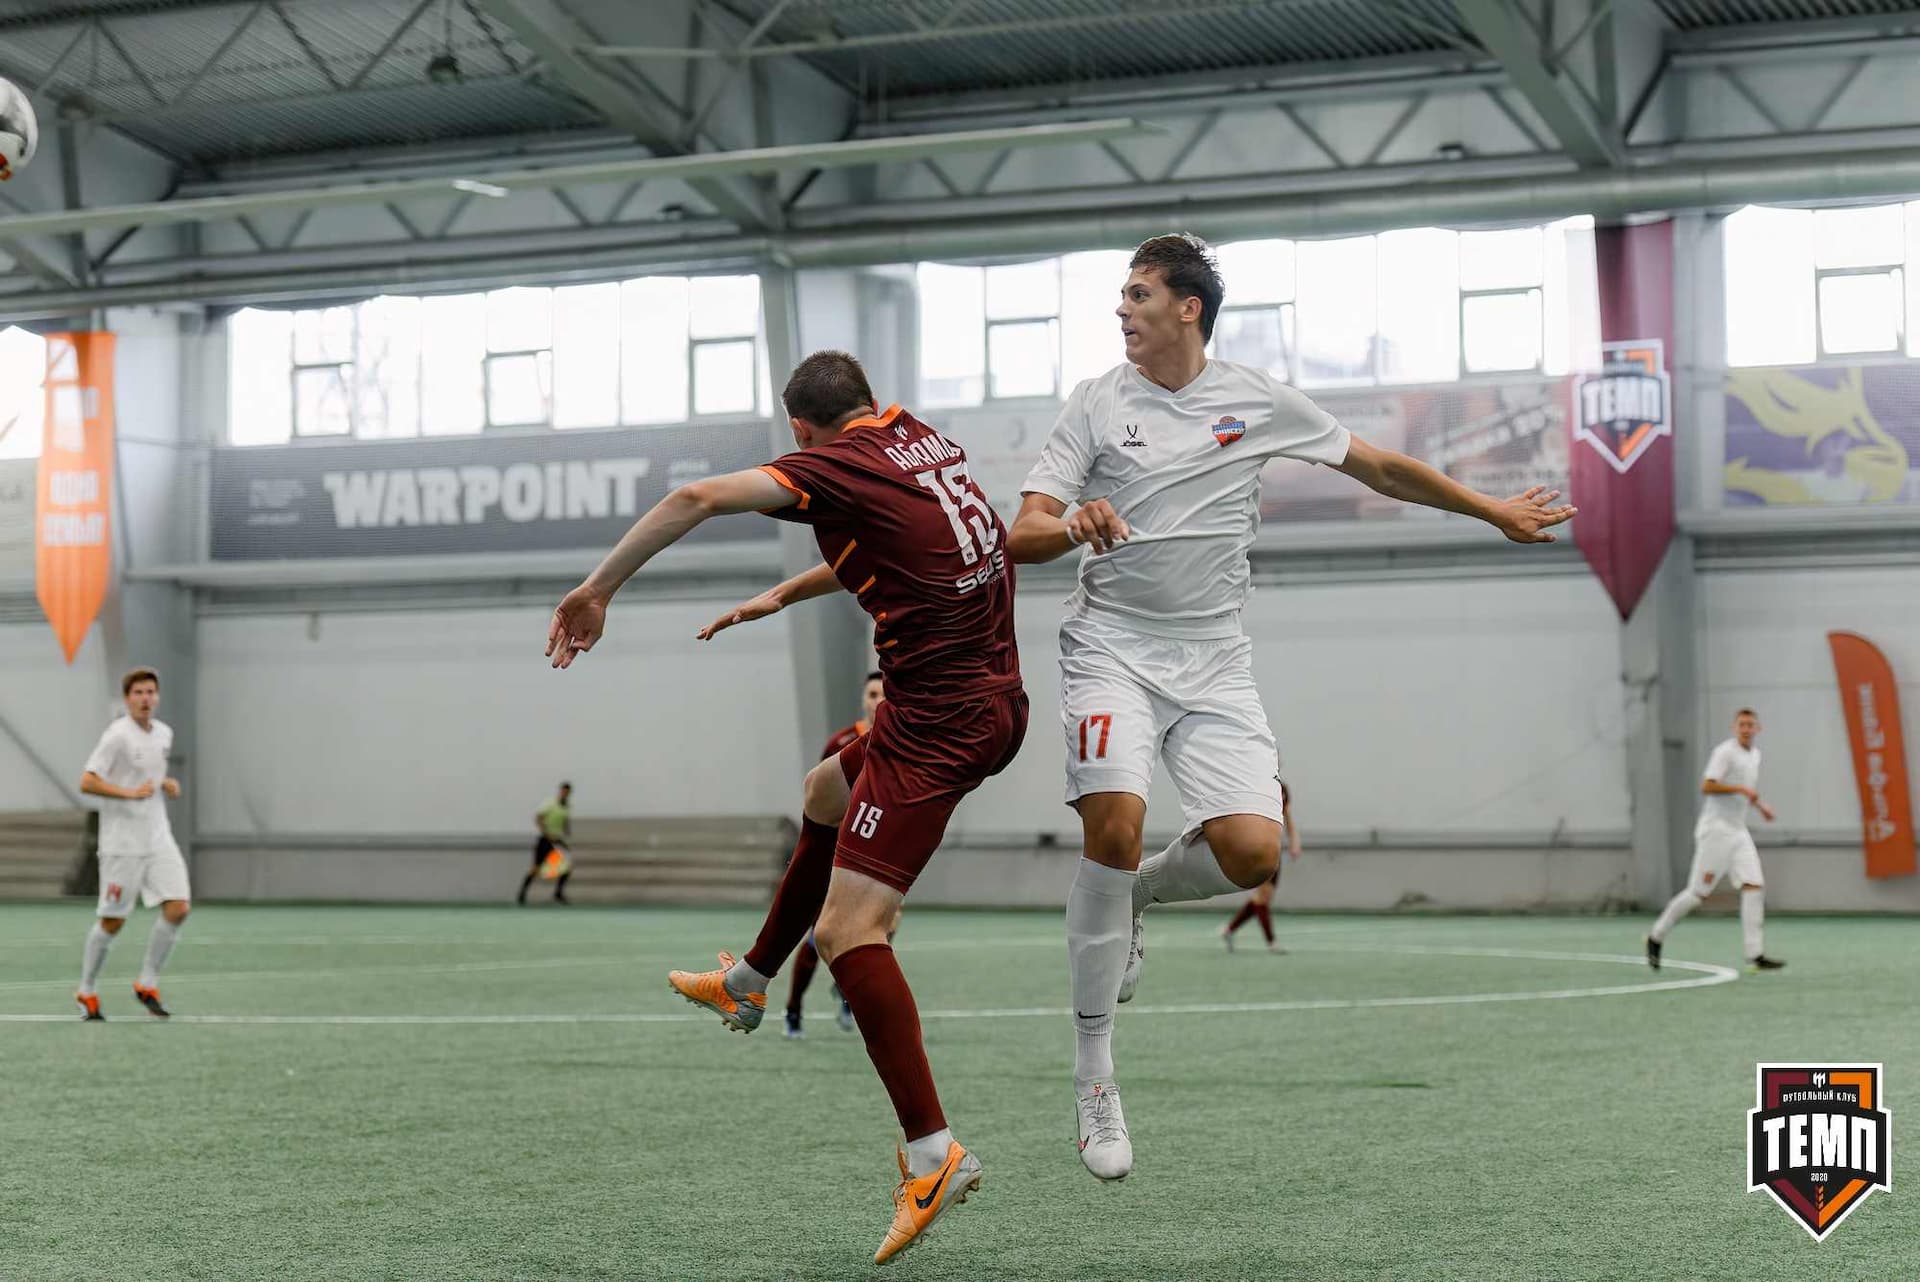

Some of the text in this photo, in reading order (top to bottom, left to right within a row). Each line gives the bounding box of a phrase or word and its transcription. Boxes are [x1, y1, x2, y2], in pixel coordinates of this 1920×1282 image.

[1583, 376, 1661, 428] ТЕМП
[322, 457, 650, 529] WARPOINT
[915, 461, 998, 566] 15
[1078, 713, 1112, 762] 17
[850, 801, 883, 839] 15
